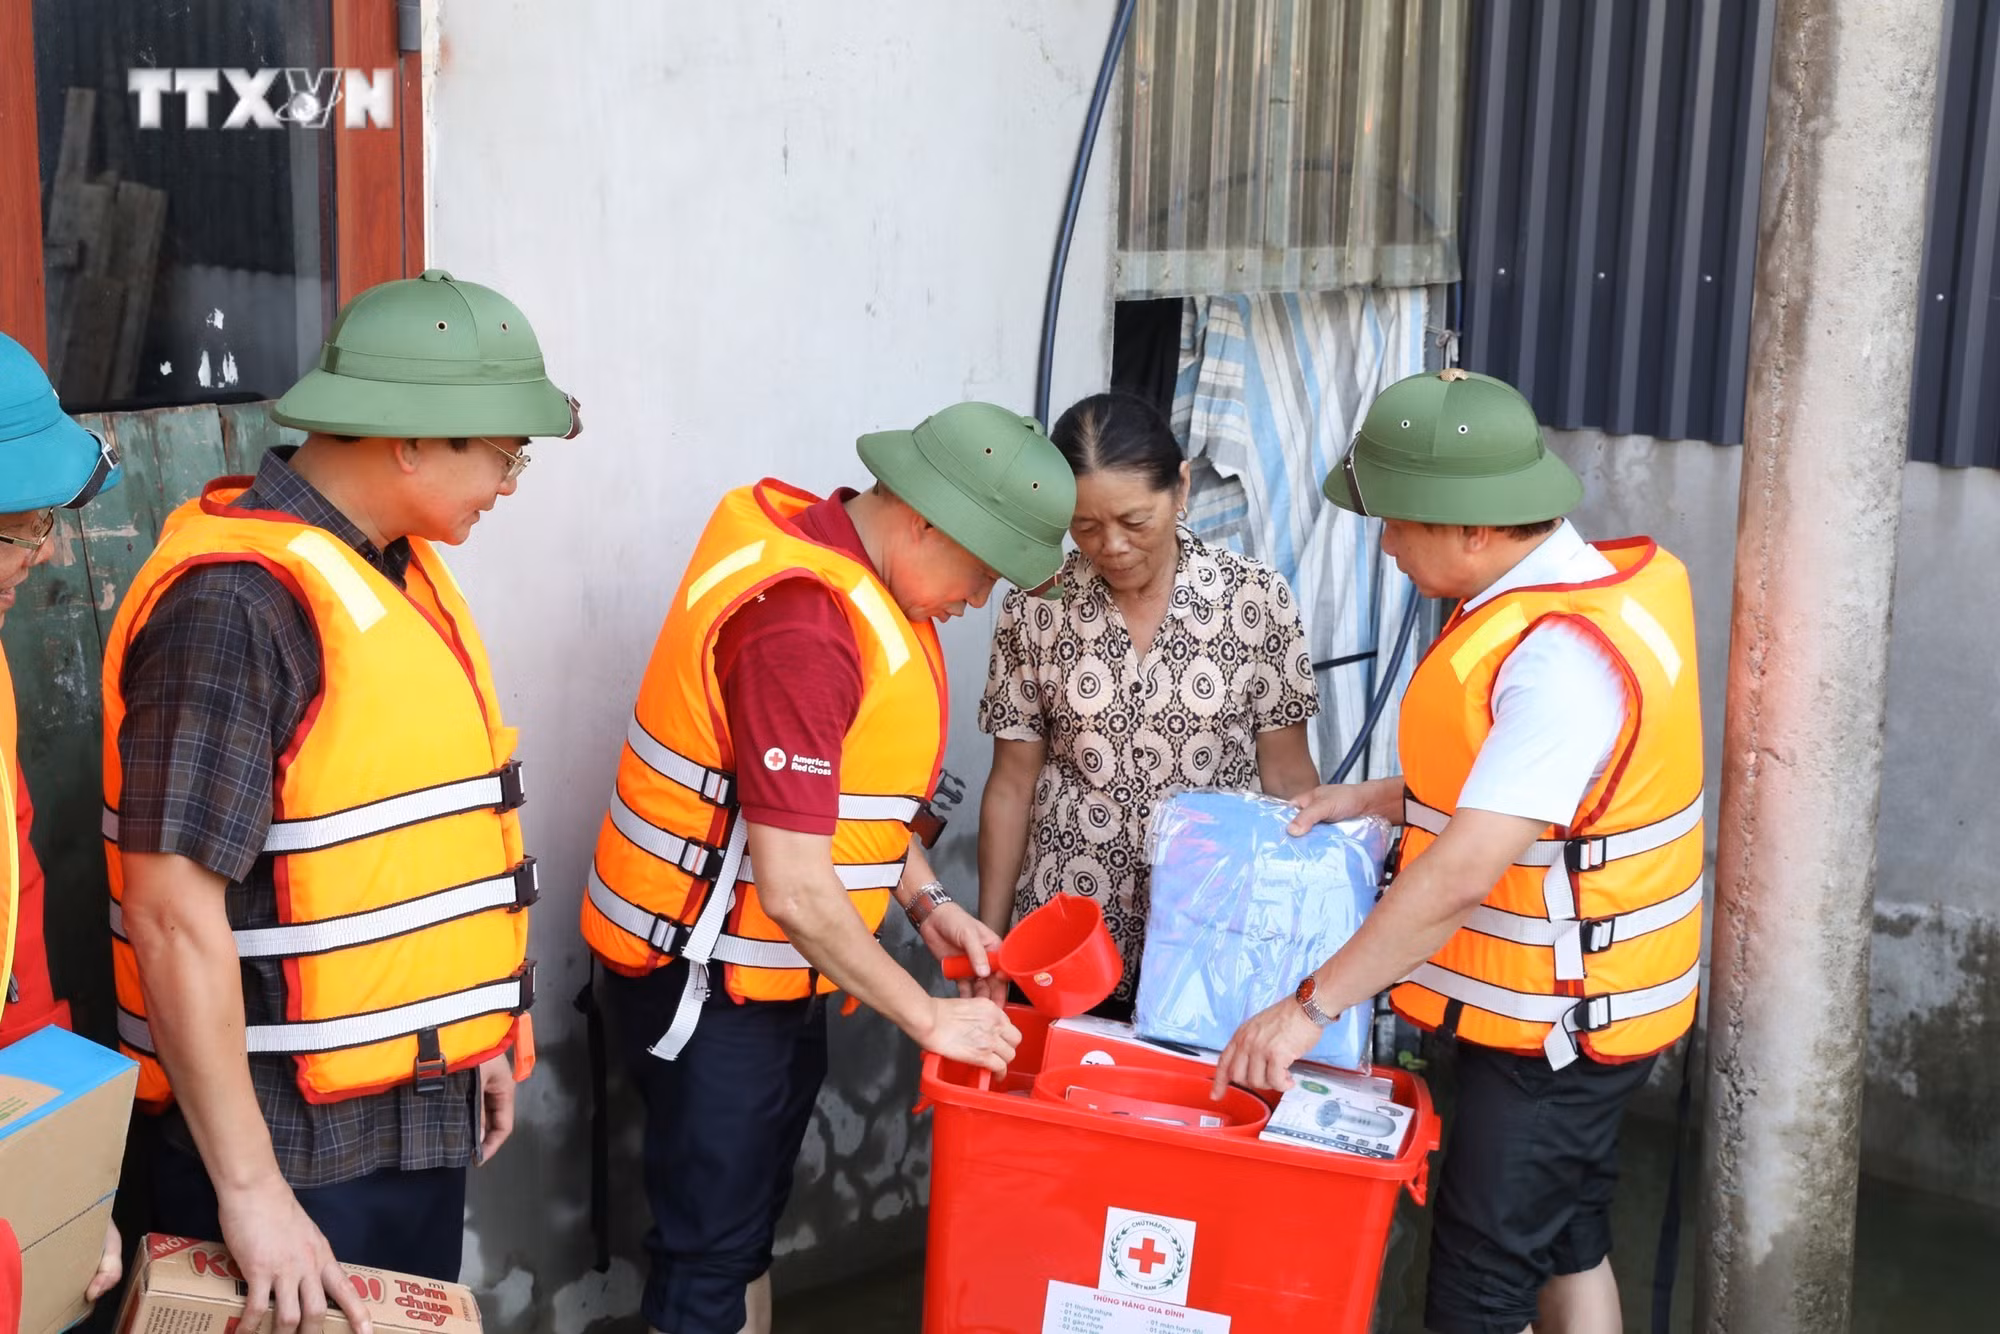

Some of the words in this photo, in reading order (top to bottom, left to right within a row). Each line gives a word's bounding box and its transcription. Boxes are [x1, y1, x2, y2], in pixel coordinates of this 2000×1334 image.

[791, 762, 807, 772] Red
[807, 765, 832, 775] Cross
[394, 1279, 448, 1301] Tôm
[394, 1295, 454, 1315] chua
[1121, 1299, 1146, 1311] HÀNG
[1147, 1305, 1162, 1314] GIA
[1164, 1308, 1185, 1319] ĐÌNH
[405, 1309, 448, 1327] cay
